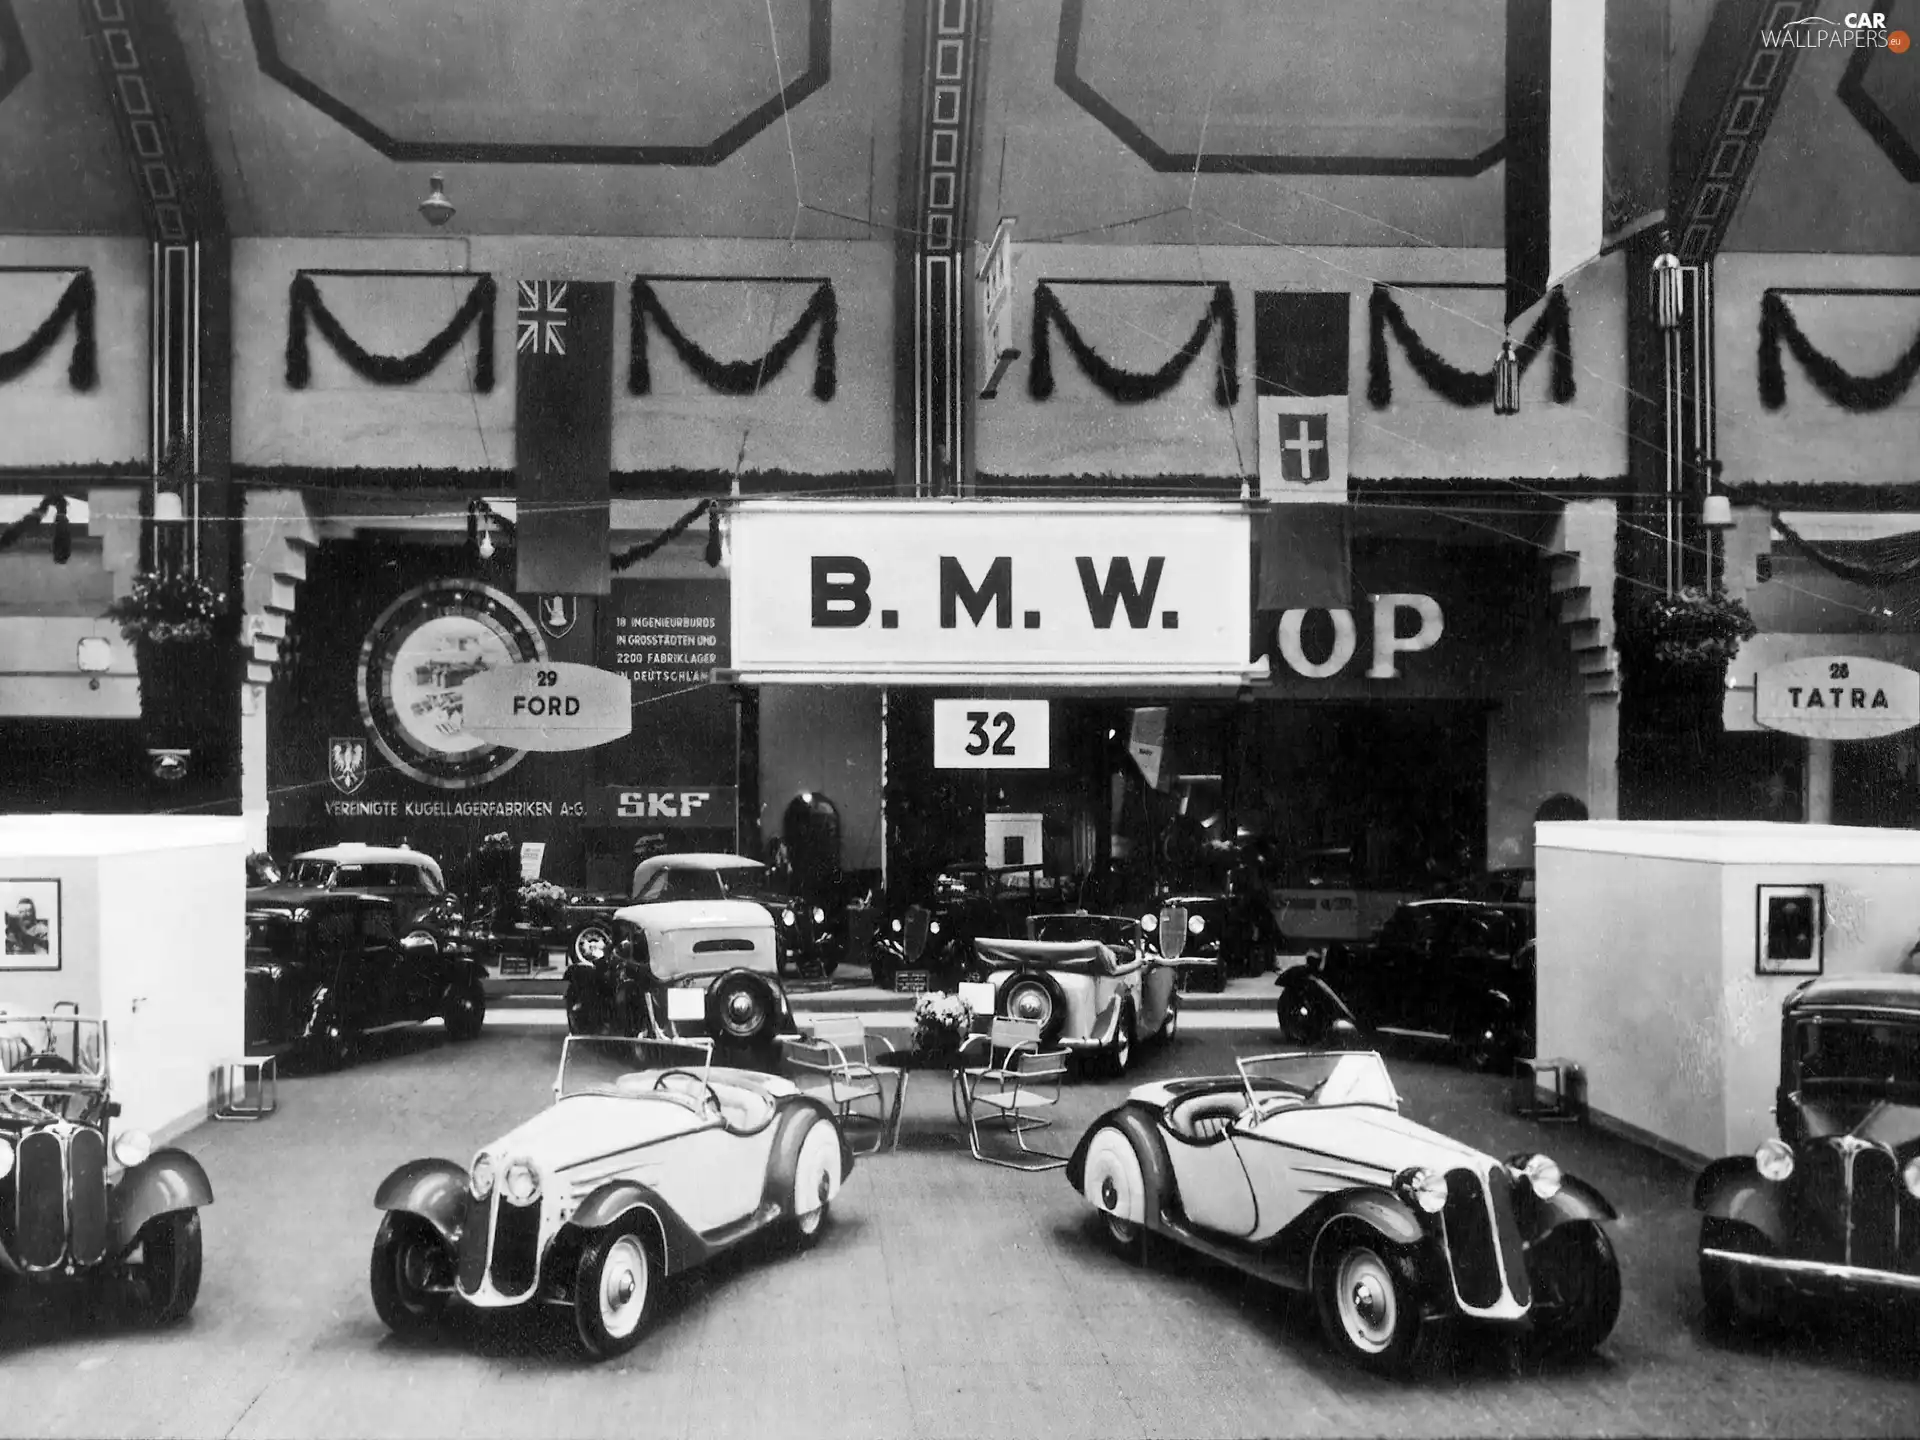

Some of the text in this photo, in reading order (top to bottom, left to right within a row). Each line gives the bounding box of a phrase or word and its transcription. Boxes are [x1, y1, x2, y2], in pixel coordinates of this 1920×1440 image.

[617, 653, 717, 664] 2200 FABRIKLAGER
[537, 670, 557, 687] 29
[513, 696, 580, 715] FORD
[1788, 688, 1889, 709] TATRA
[965, 711, 1015, 755] 32
[325, 801, 398, 816] VEREINIGTE
[405, 801, 552, 817] KUGELLAGERFABRIKEN
[617, 792, 710, 817] SKF
